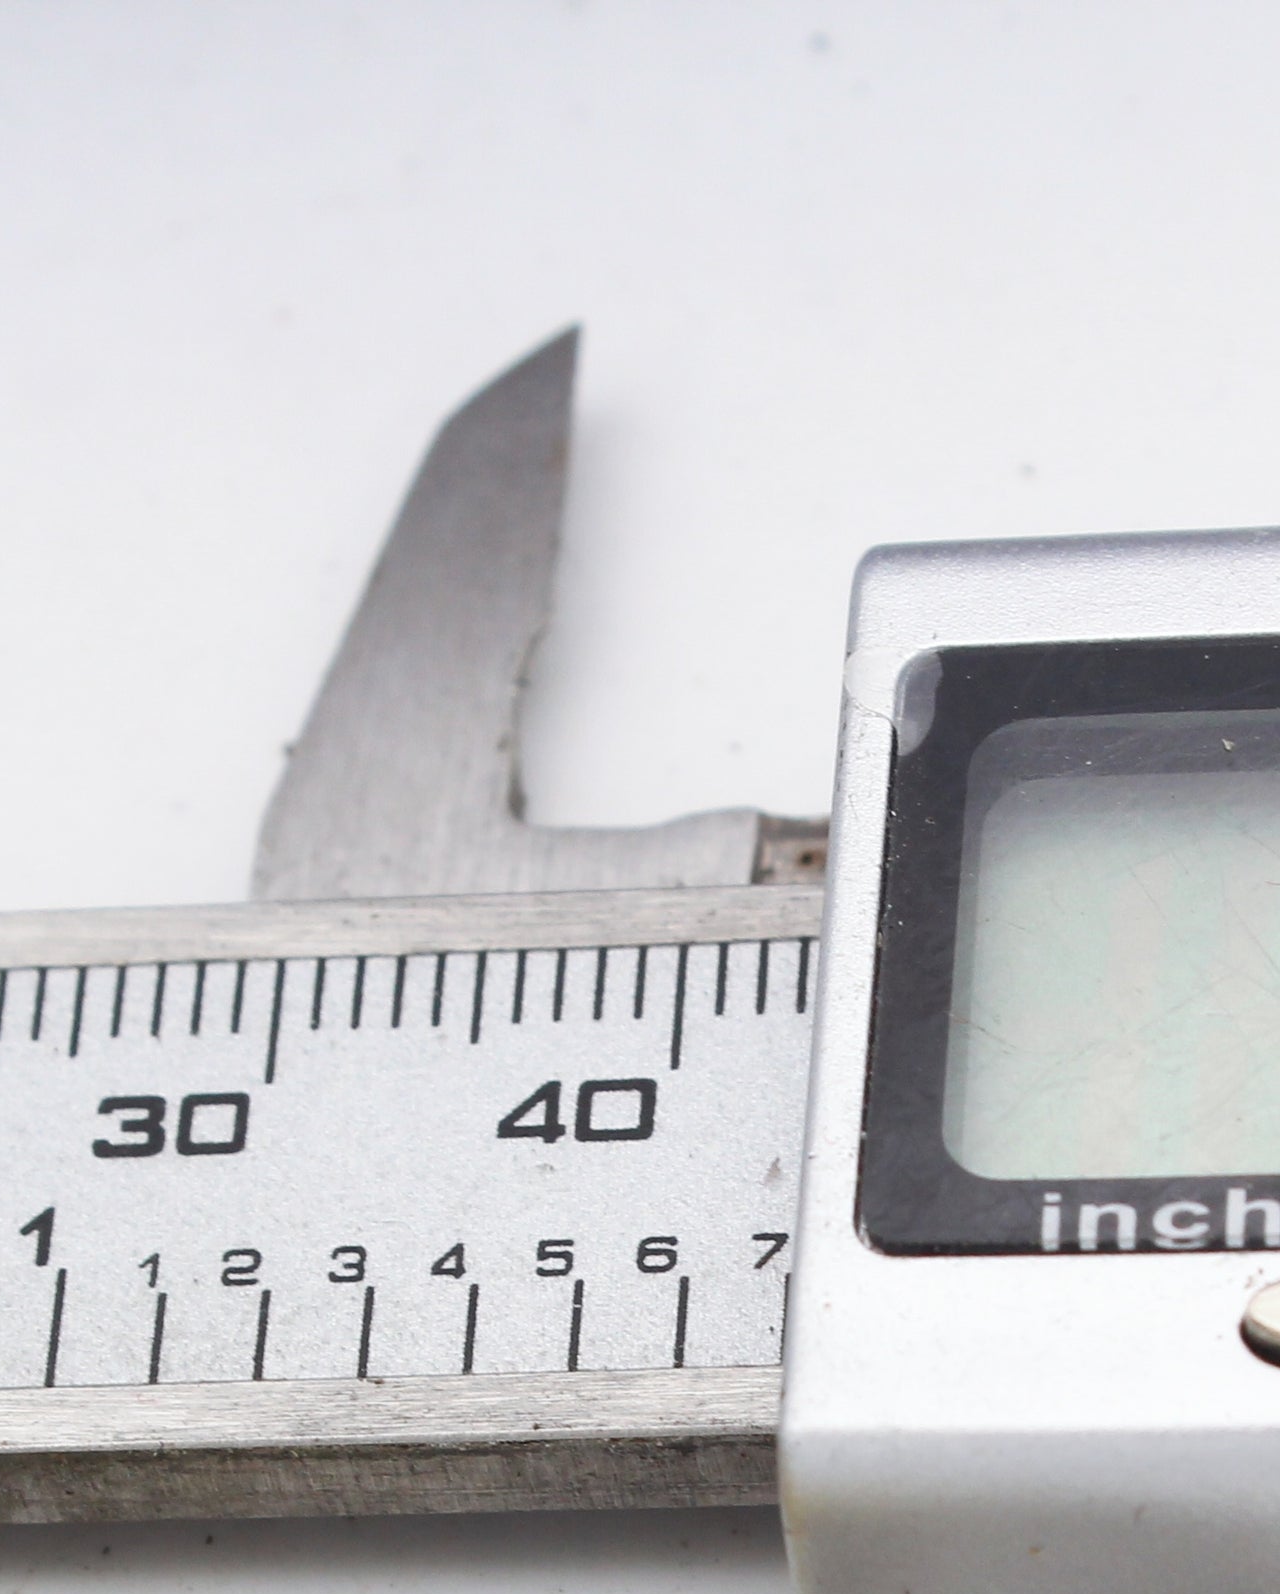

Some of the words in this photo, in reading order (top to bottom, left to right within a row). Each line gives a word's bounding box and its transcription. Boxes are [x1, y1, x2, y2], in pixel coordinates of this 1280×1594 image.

[91, 1091, 251, 1160] 30
[496, 1077, 658, 1145] 40
[19, 1206, 56, 1268] 1
[138, 1252, 161, 1289] 1
[220, 1248, 263, 1287] 2
[327, 1245, 368, 1284] 3
[430, 1242, 467, 1280] 4
[535, 1238, 575, 1278] 5
[635, 1235, 679, 1275] 6
[751, 1232, 790, 1270] 7
